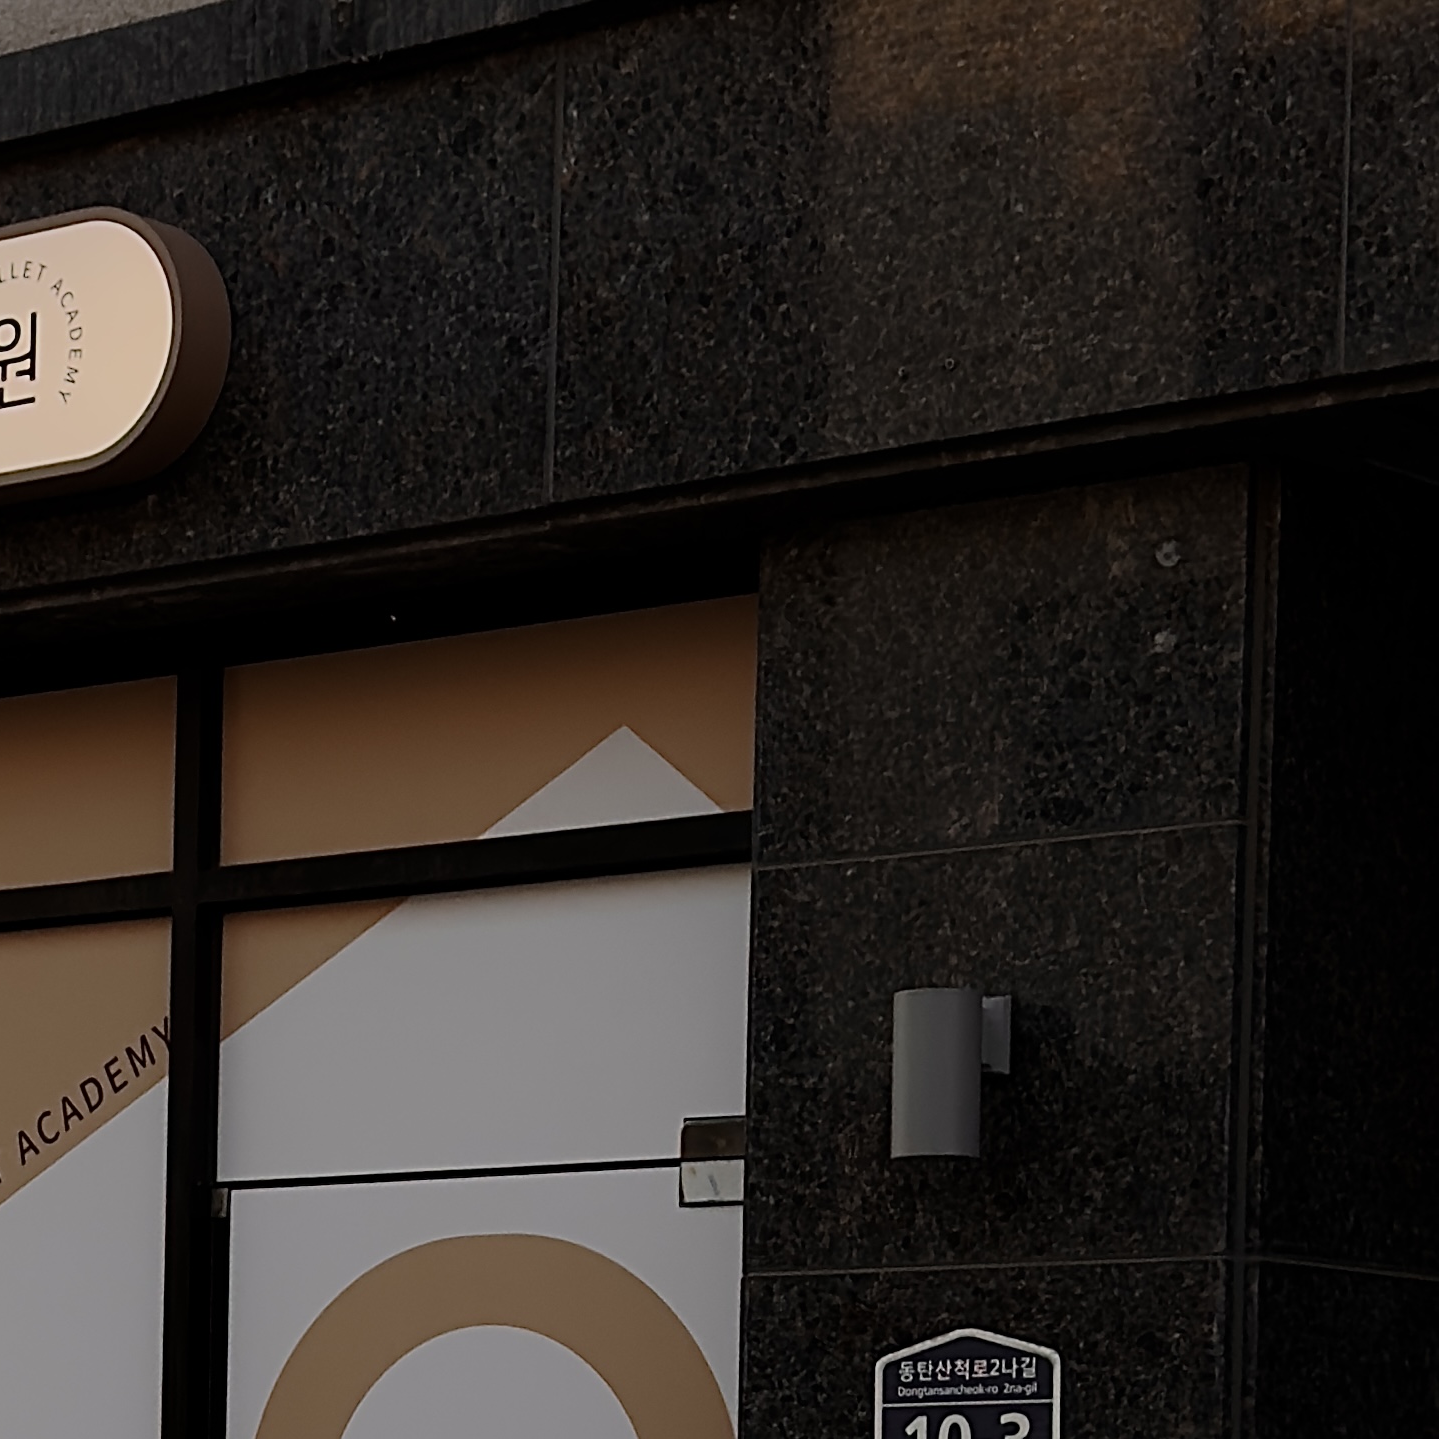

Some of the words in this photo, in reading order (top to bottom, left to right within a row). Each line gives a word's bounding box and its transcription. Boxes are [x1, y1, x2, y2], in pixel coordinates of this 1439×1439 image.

[50, 278, 84, 405] ACADEMY
[16, 1016, 172, 1166] ACADEMY
[898, 1356, 1037, 1383] 동탄산척로2나길
[1002, 1381, 1038, 1397] 2na-gil
